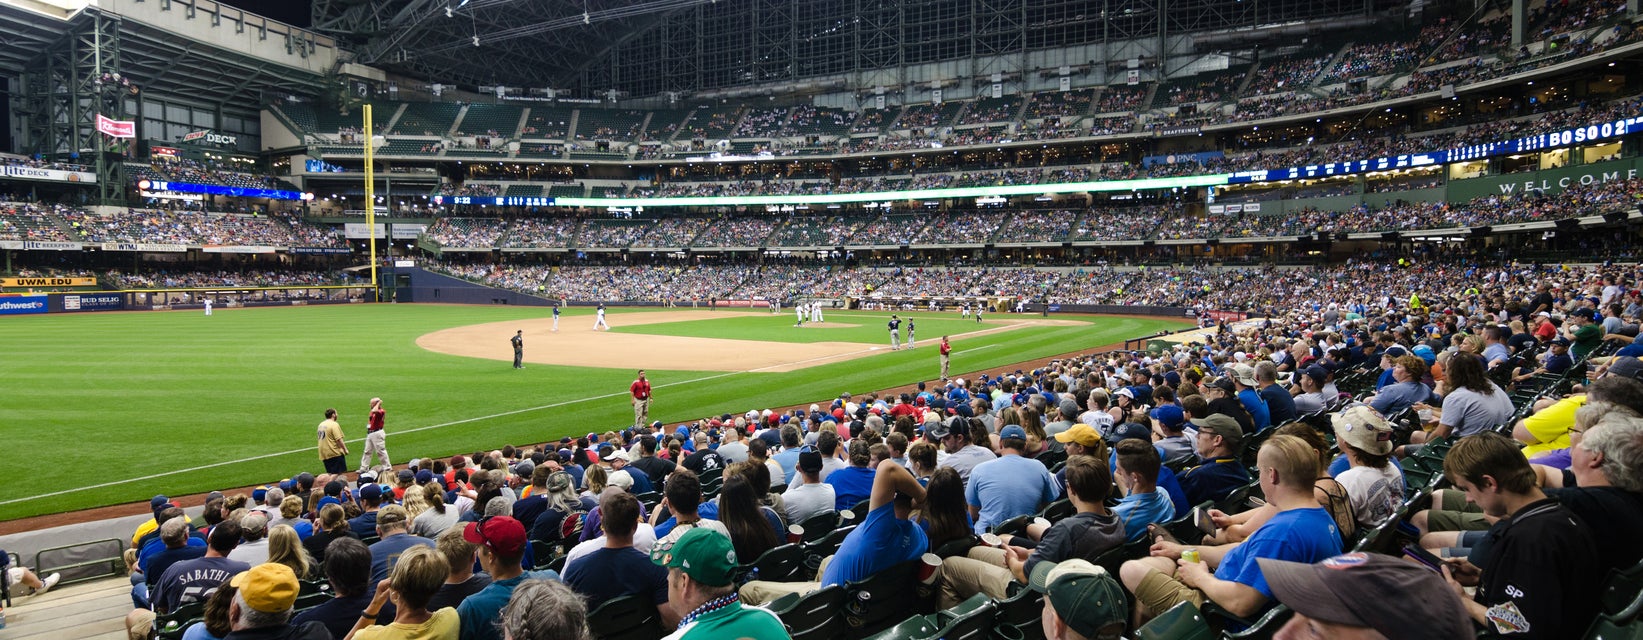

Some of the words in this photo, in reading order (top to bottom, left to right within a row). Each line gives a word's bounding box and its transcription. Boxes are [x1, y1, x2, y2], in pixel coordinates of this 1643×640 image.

[1163, 127, 1199, 135] DRAFTKINGS
[206, 133, 237, 145] DECK
[1177, 154, 1197, 163] PNC
[1498, 169, 1638, 194] WELCOME
[17, 278, 72, 286] UWM.EDU
[179, 568, 231, 585] SABATHI
[1504, 584, 1524, 599] SP
